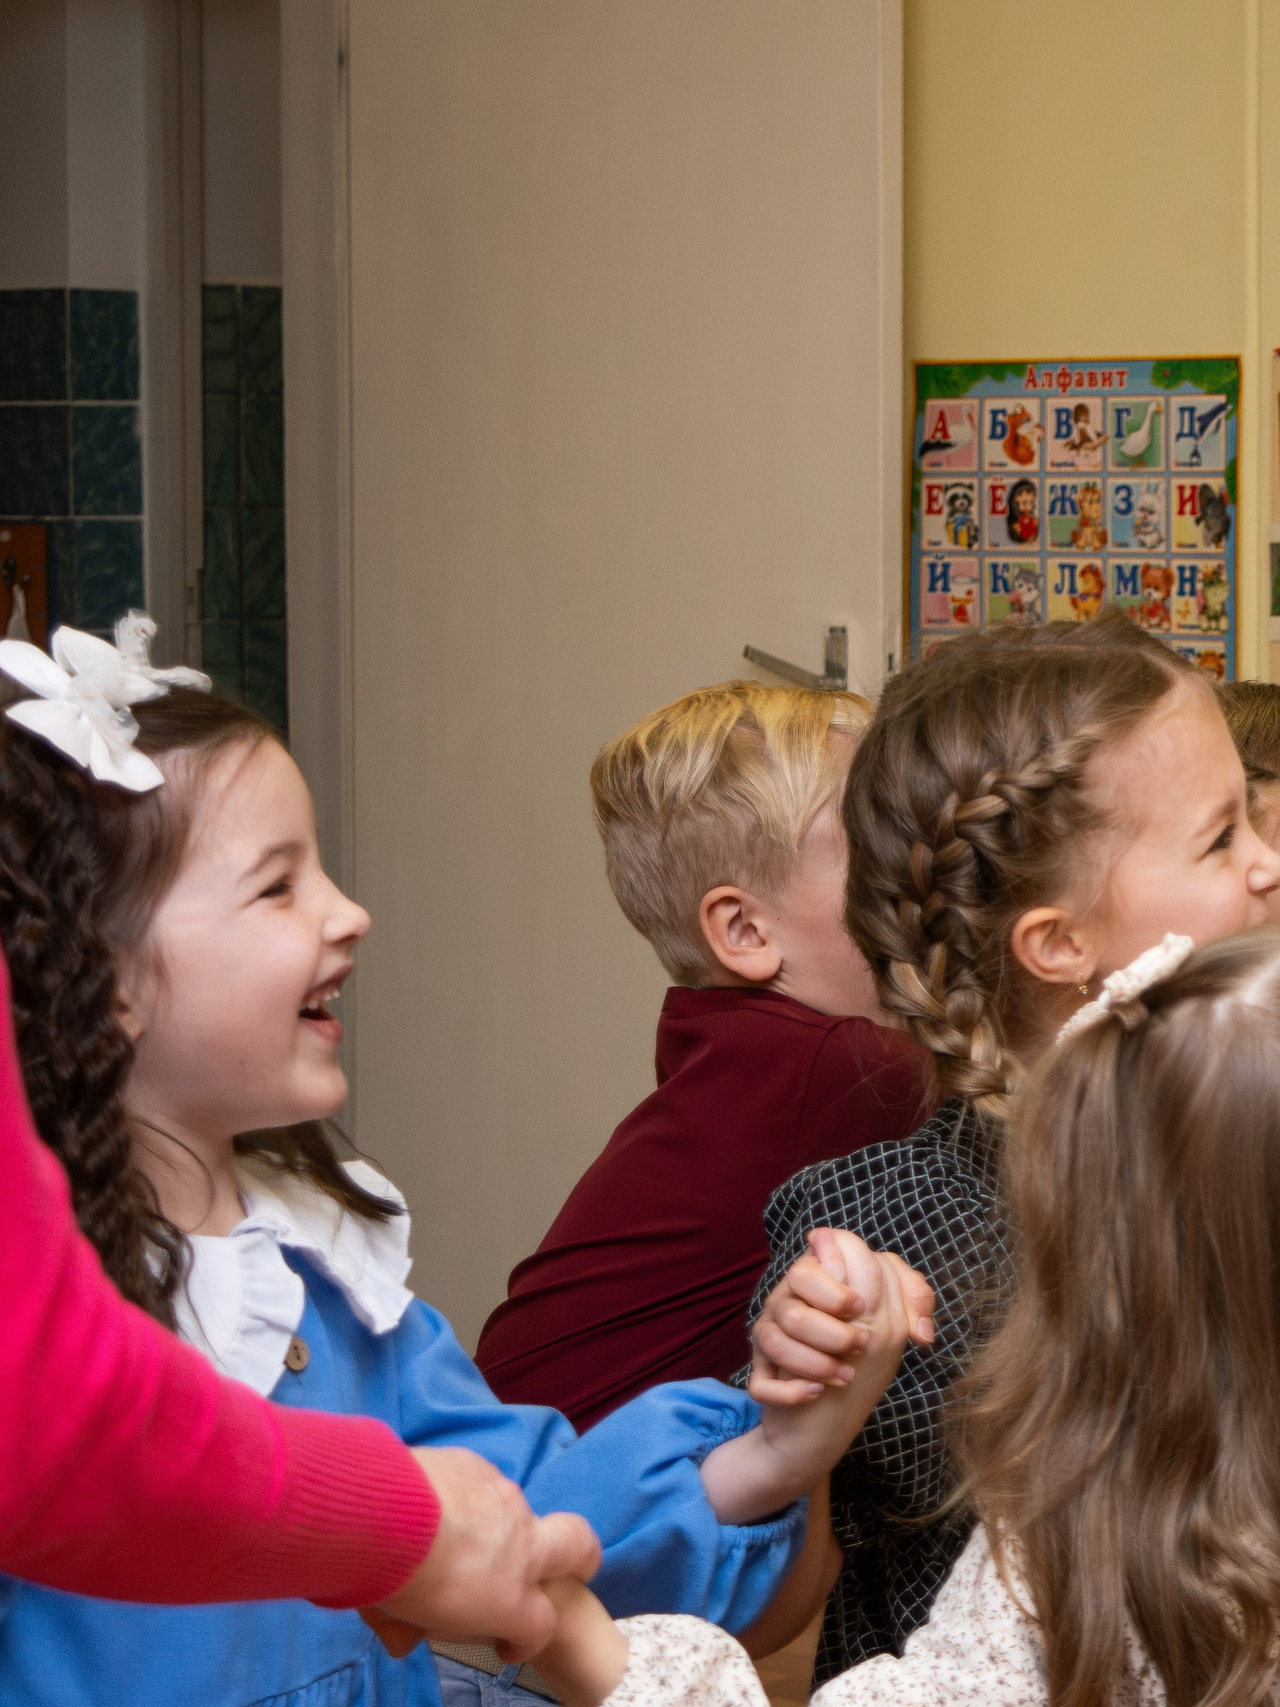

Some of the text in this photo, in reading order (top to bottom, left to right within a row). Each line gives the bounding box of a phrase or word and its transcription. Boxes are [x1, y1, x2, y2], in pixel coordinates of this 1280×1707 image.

[1024, 366, 1128, 394] Алфавит
[930, 406, 1198, 442] А Б В Г Д
[926, 476, 1198, 516] Е Ё Ж З И
[927, 554, 1197, 597] Й К Л М Н
